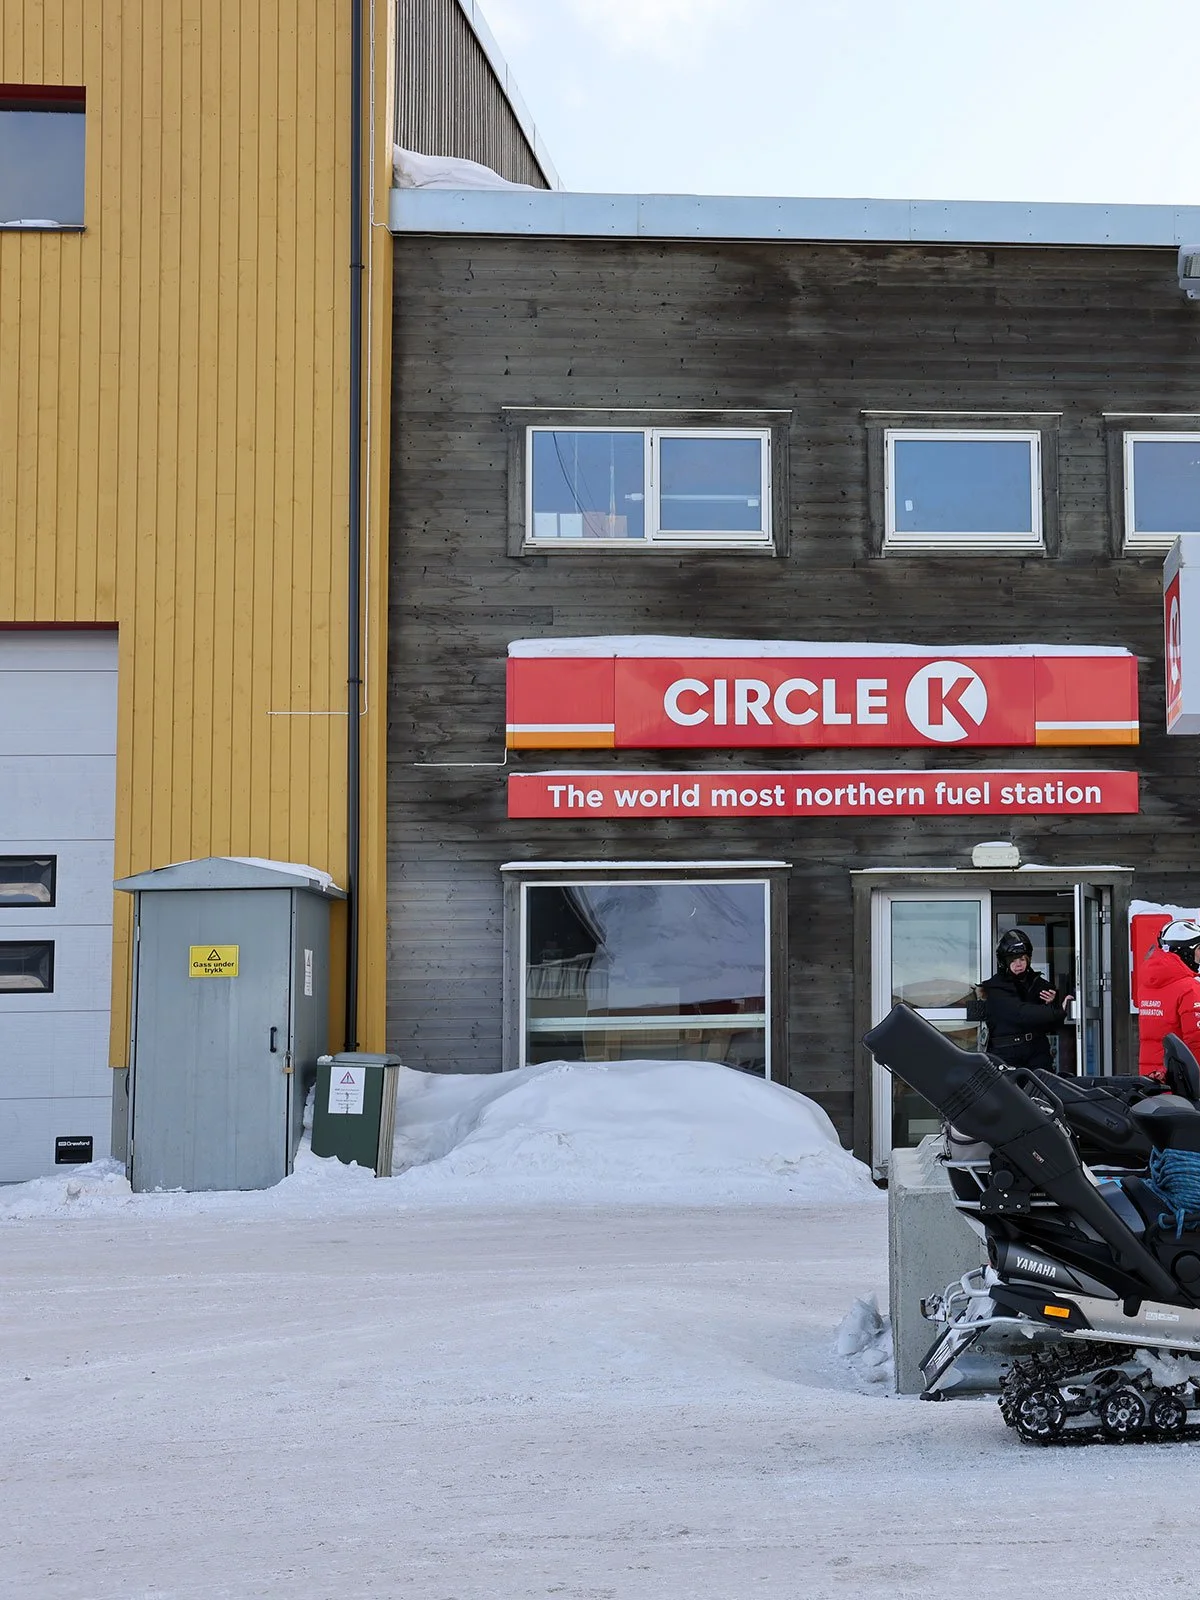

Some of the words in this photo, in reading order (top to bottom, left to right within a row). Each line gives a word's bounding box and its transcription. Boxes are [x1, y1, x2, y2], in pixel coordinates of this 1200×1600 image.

[663, 677, 888, 727] CIRCLE
[924, 674, 984, 735] K
[547, 784, 604, 808] The
[613, 783, 700, 808] world
[711, 784, 786, 807] most
[796, 782, 925, 806] northern
[934, 781, 990, 805] fuel
[1000, 780, 1102, 805] station
[204, 967, 223, 975] trykk
[1016, 1255, 1057, 1279] YAMAHA
